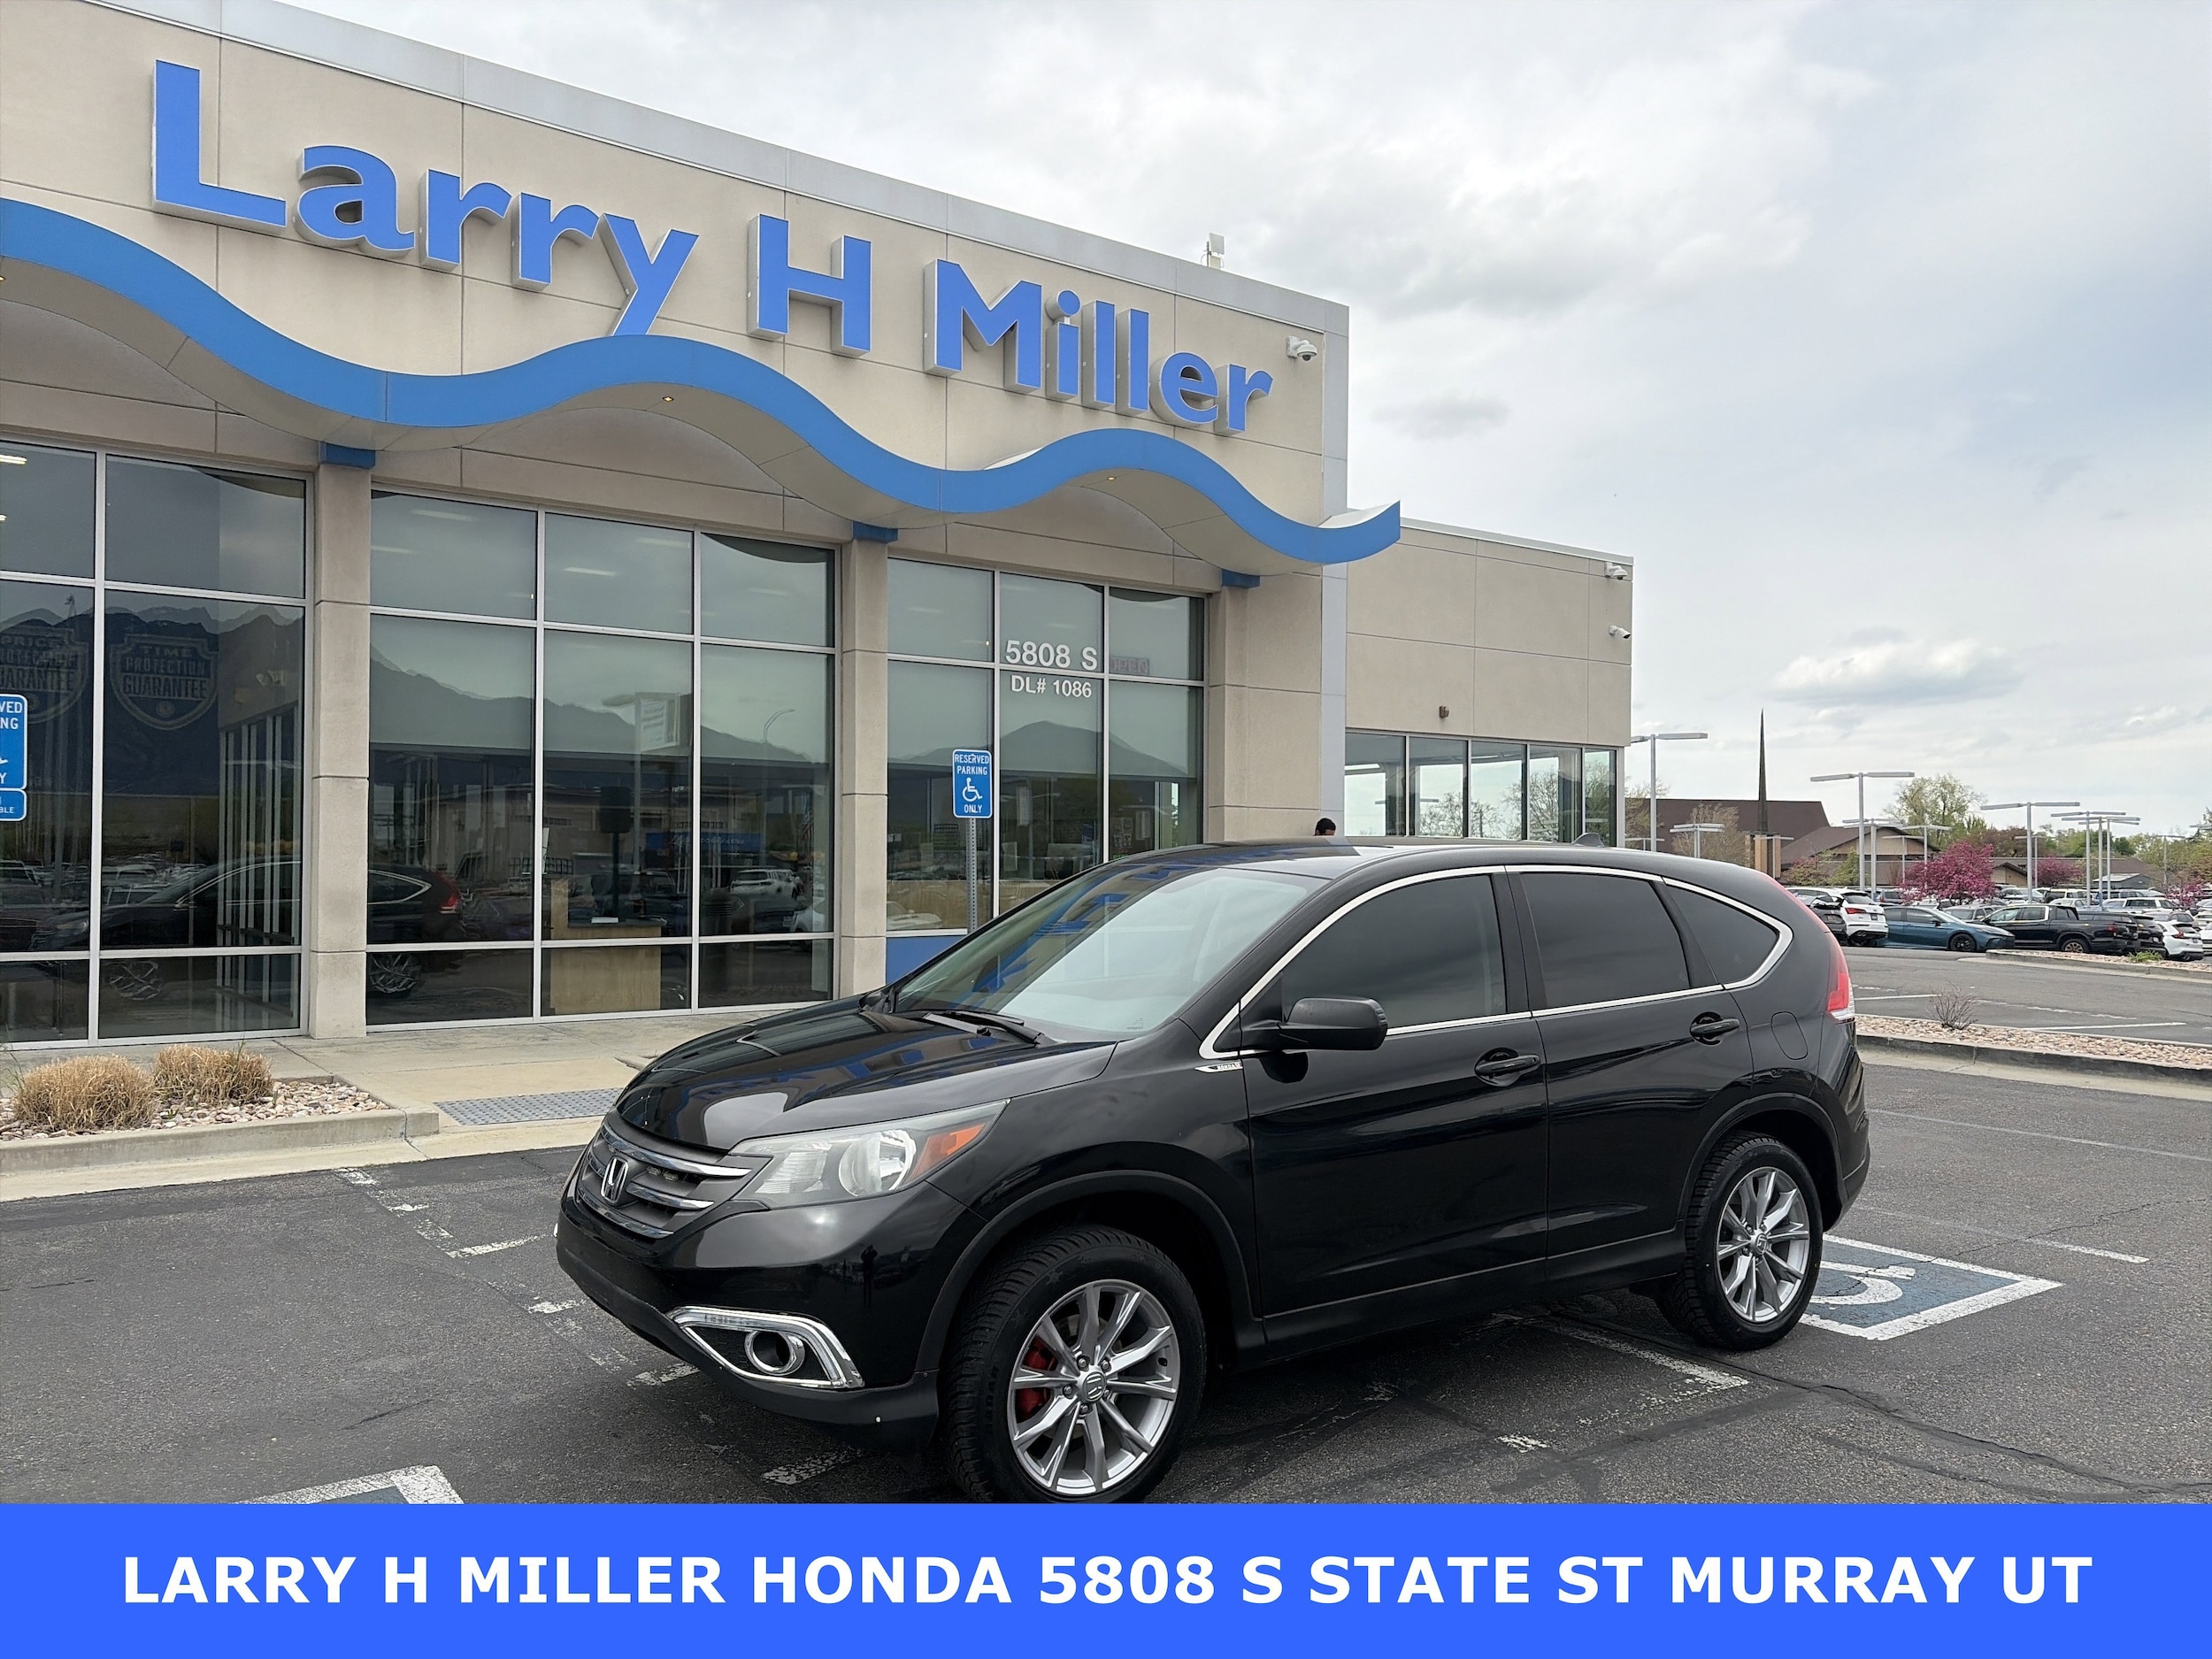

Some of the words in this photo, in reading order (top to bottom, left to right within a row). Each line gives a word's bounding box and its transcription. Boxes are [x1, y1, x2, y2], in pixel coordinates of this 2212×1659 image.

[153, 59, 699, 336] Larry
[748, 213, 872, 356] H
[923, 258, 1273, 437] Miller
[140, 645, 192, 657] TIME
[1005, 639, 1071, 668] 5808
[1081, 646, 1098, 671] S
[126, 656, 205, 676] PROTECTION
[123, 674, 208, 699] GUARANTEE
[1011, 674, 1047, 694] DL#
[1053, 679, 1093, 698] 1086
[955, 753, 989, 764] RESERVED
[956, 765, 988, 775] PARKING
[964, 803, 982, 813] ONLY
